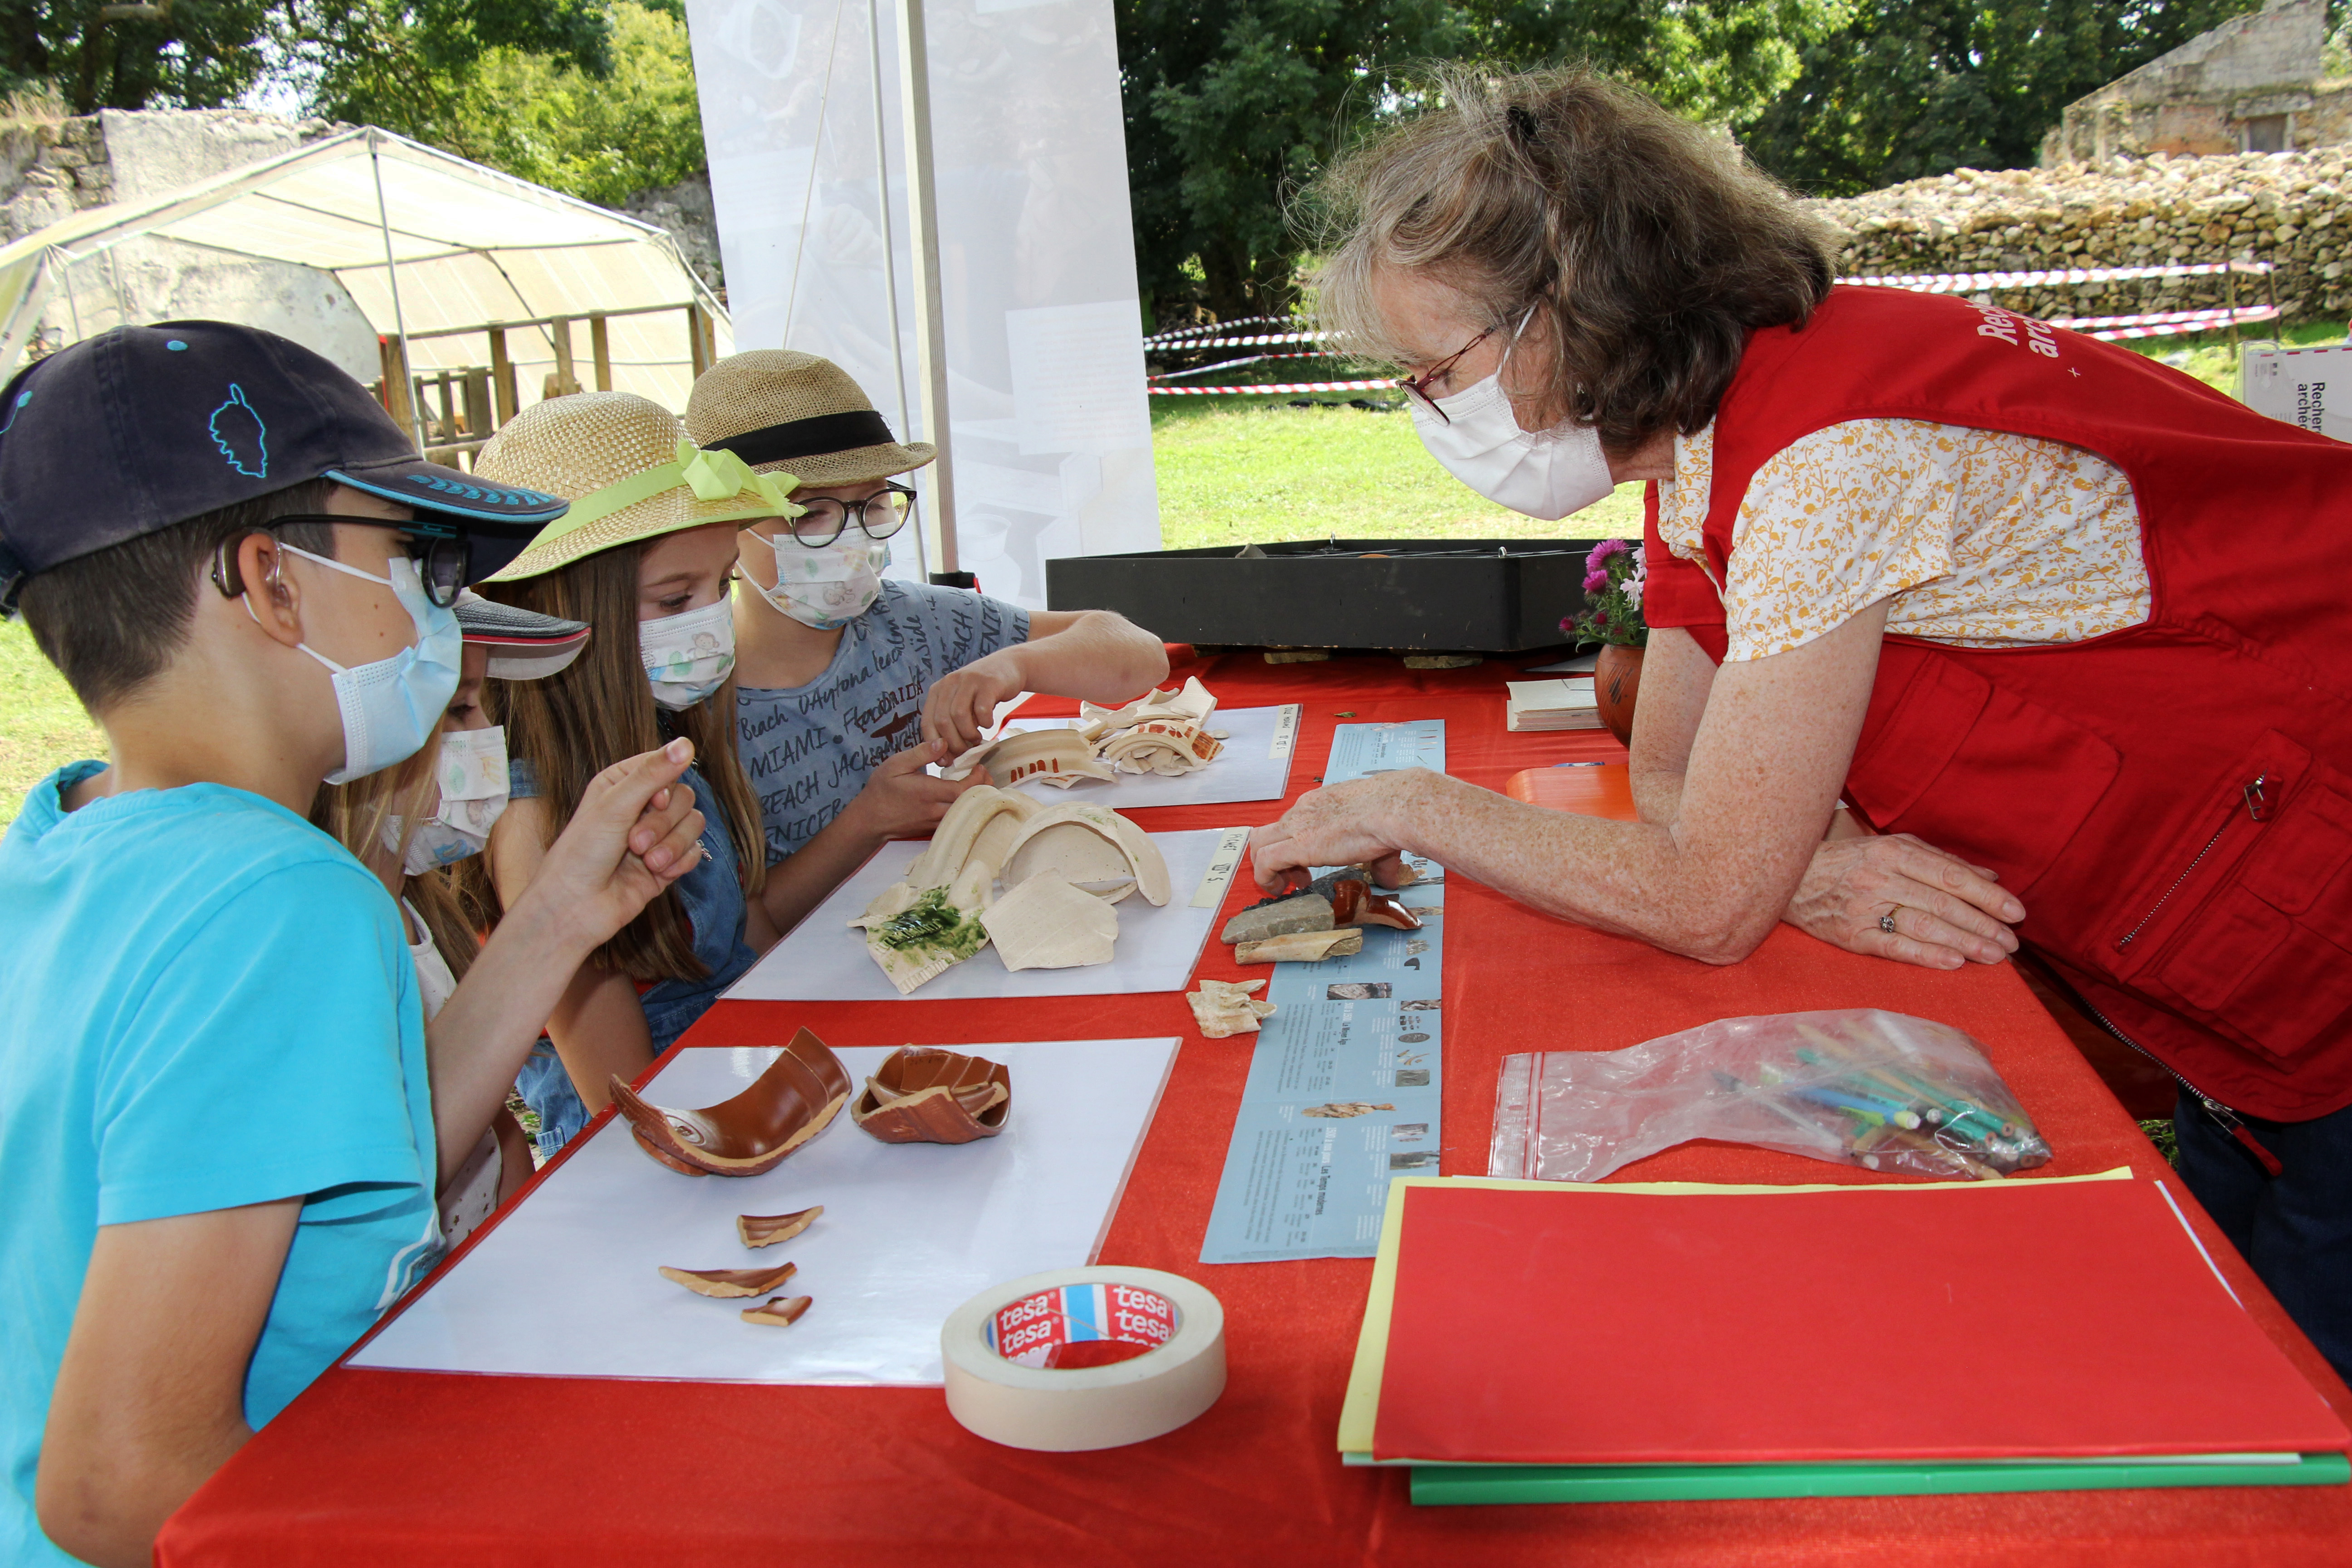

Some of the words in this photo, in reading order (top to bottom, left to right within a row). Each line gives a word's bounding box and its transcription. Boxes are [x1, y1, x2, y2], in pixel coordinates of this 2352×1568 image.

[740, 704, 789, 741] Beach
[750, 726, 828, 781] MIAMI
[1000, 1295, 1048, 1331] tesa
[1113, 1285, 1168, 1320] tesa
[1002, 1320, 1052, 1353] tesa
[1114, 1309, 1171, 1342] tesa
